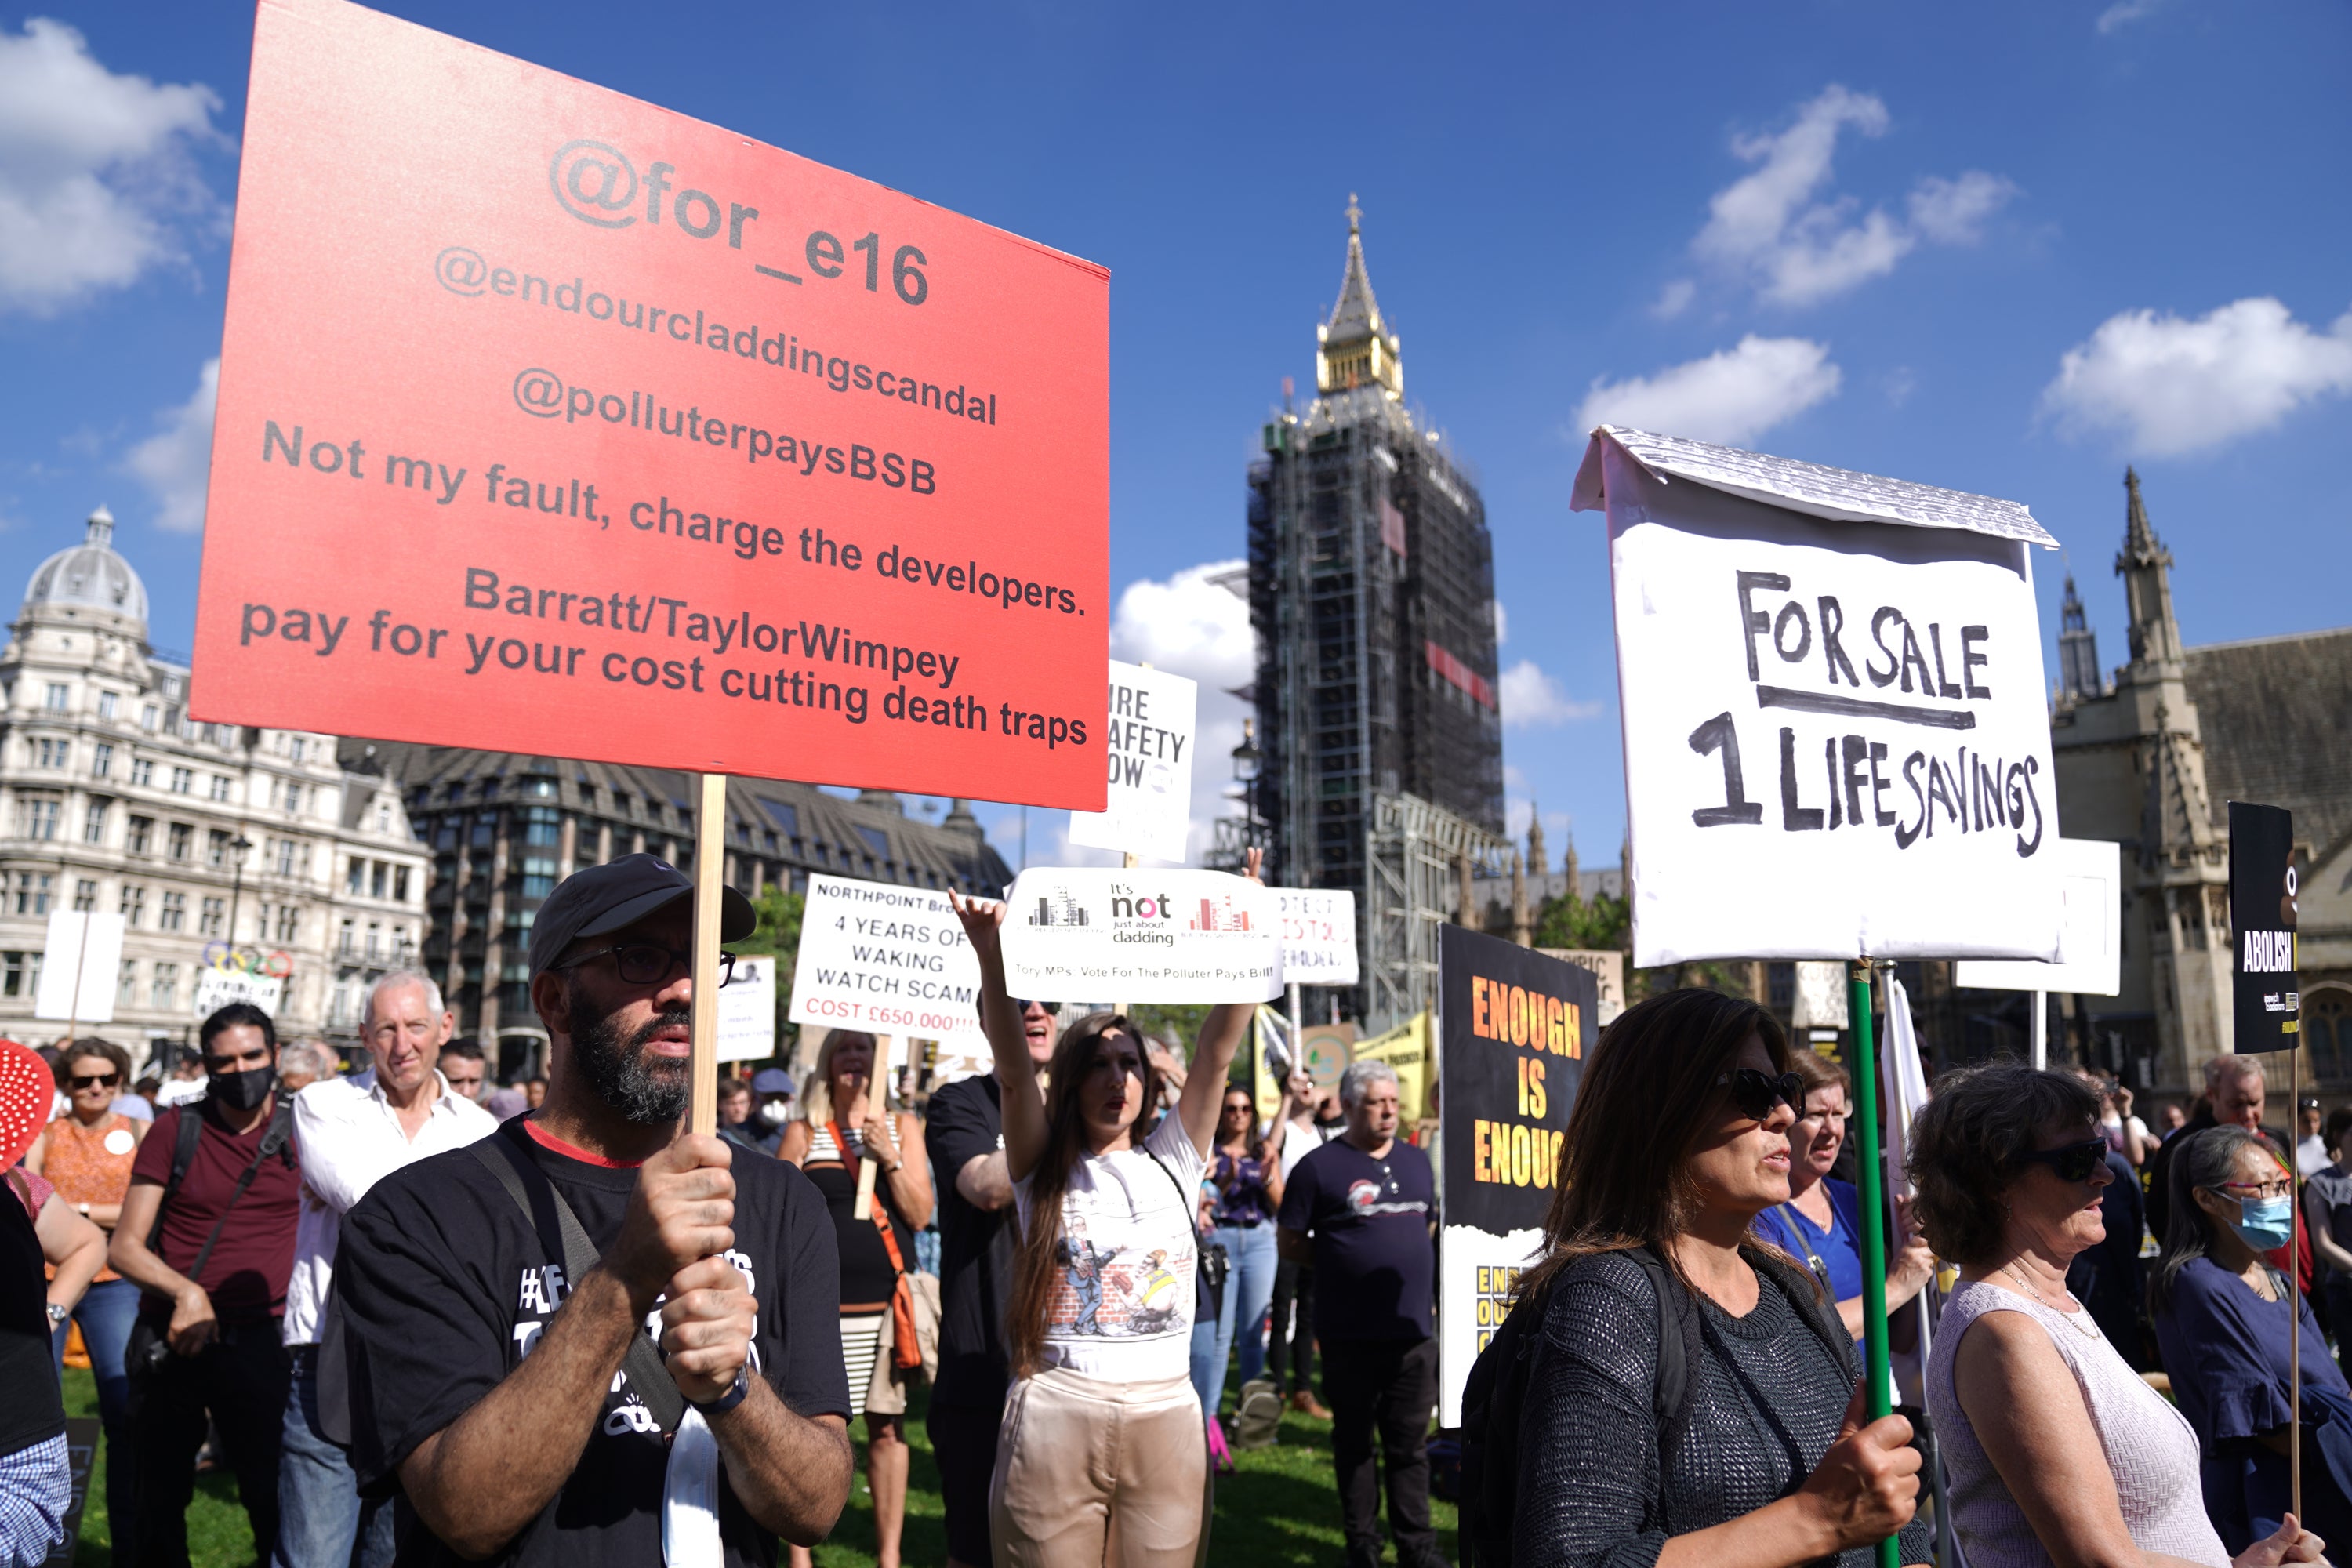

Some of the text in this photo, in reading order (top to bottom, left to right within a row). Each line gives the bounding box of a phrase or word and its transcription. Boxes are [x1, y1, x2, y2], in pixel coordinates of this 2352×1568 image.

[549, 138, 929, 306] @for_e16
[435, 245, 997, 426] @endourcladdingscandal
[513, 368, 937, 495] @polluterpaysBSB
[263, 419, 1086, 616] Not my fault, charge the developers.
[464, 566, 960, 689] Barratt/TaylorWimpey
[1735, 569, 1991, 700] FOR SALE
[240, 603, 1088, 750] pay for your cost cutting death traps
[1108, 683, 1149, 721] IRE
[1108, 718, 1185, 764] AFETY
[1108, 753, 1145, 789] OW
[1688, 710, 2043, 858] 1 LIFE SAVINGS
[817, 884, 956, 914] NORTHPOINT Bro
[1110, 883, 1134, 895] It's
[1112, 893, 1171, 919] not
[834, 915, 967, 947] 4 YEARS OF
[1112, 930, 1174, 948] cladding
[1113, 920, 1165, 930] just about
[852, 944, 944, 973] WAKING
[1016, 964, 1040, 978] Tory
[1080, 967, 1108, 978] Vote
[1112, 967, 1133, 978] For
[1137, 967, 1160, 978] The
[1163, 967, 1211, 978] Polluter
[1215, 968, 1245, 981] Pays
[2243, 930, 2292, 973] ABOLISH
[816, 967, 972, 1004] WATCH SCAM
[805, 997, 974, 1033] COST £650.000!!!
[1472, 975, 1581, 1060] ENOUGH
[1518, 1056, 1548, 1120] IS
[1474, 1119, 1566, 1191] ENOUG
